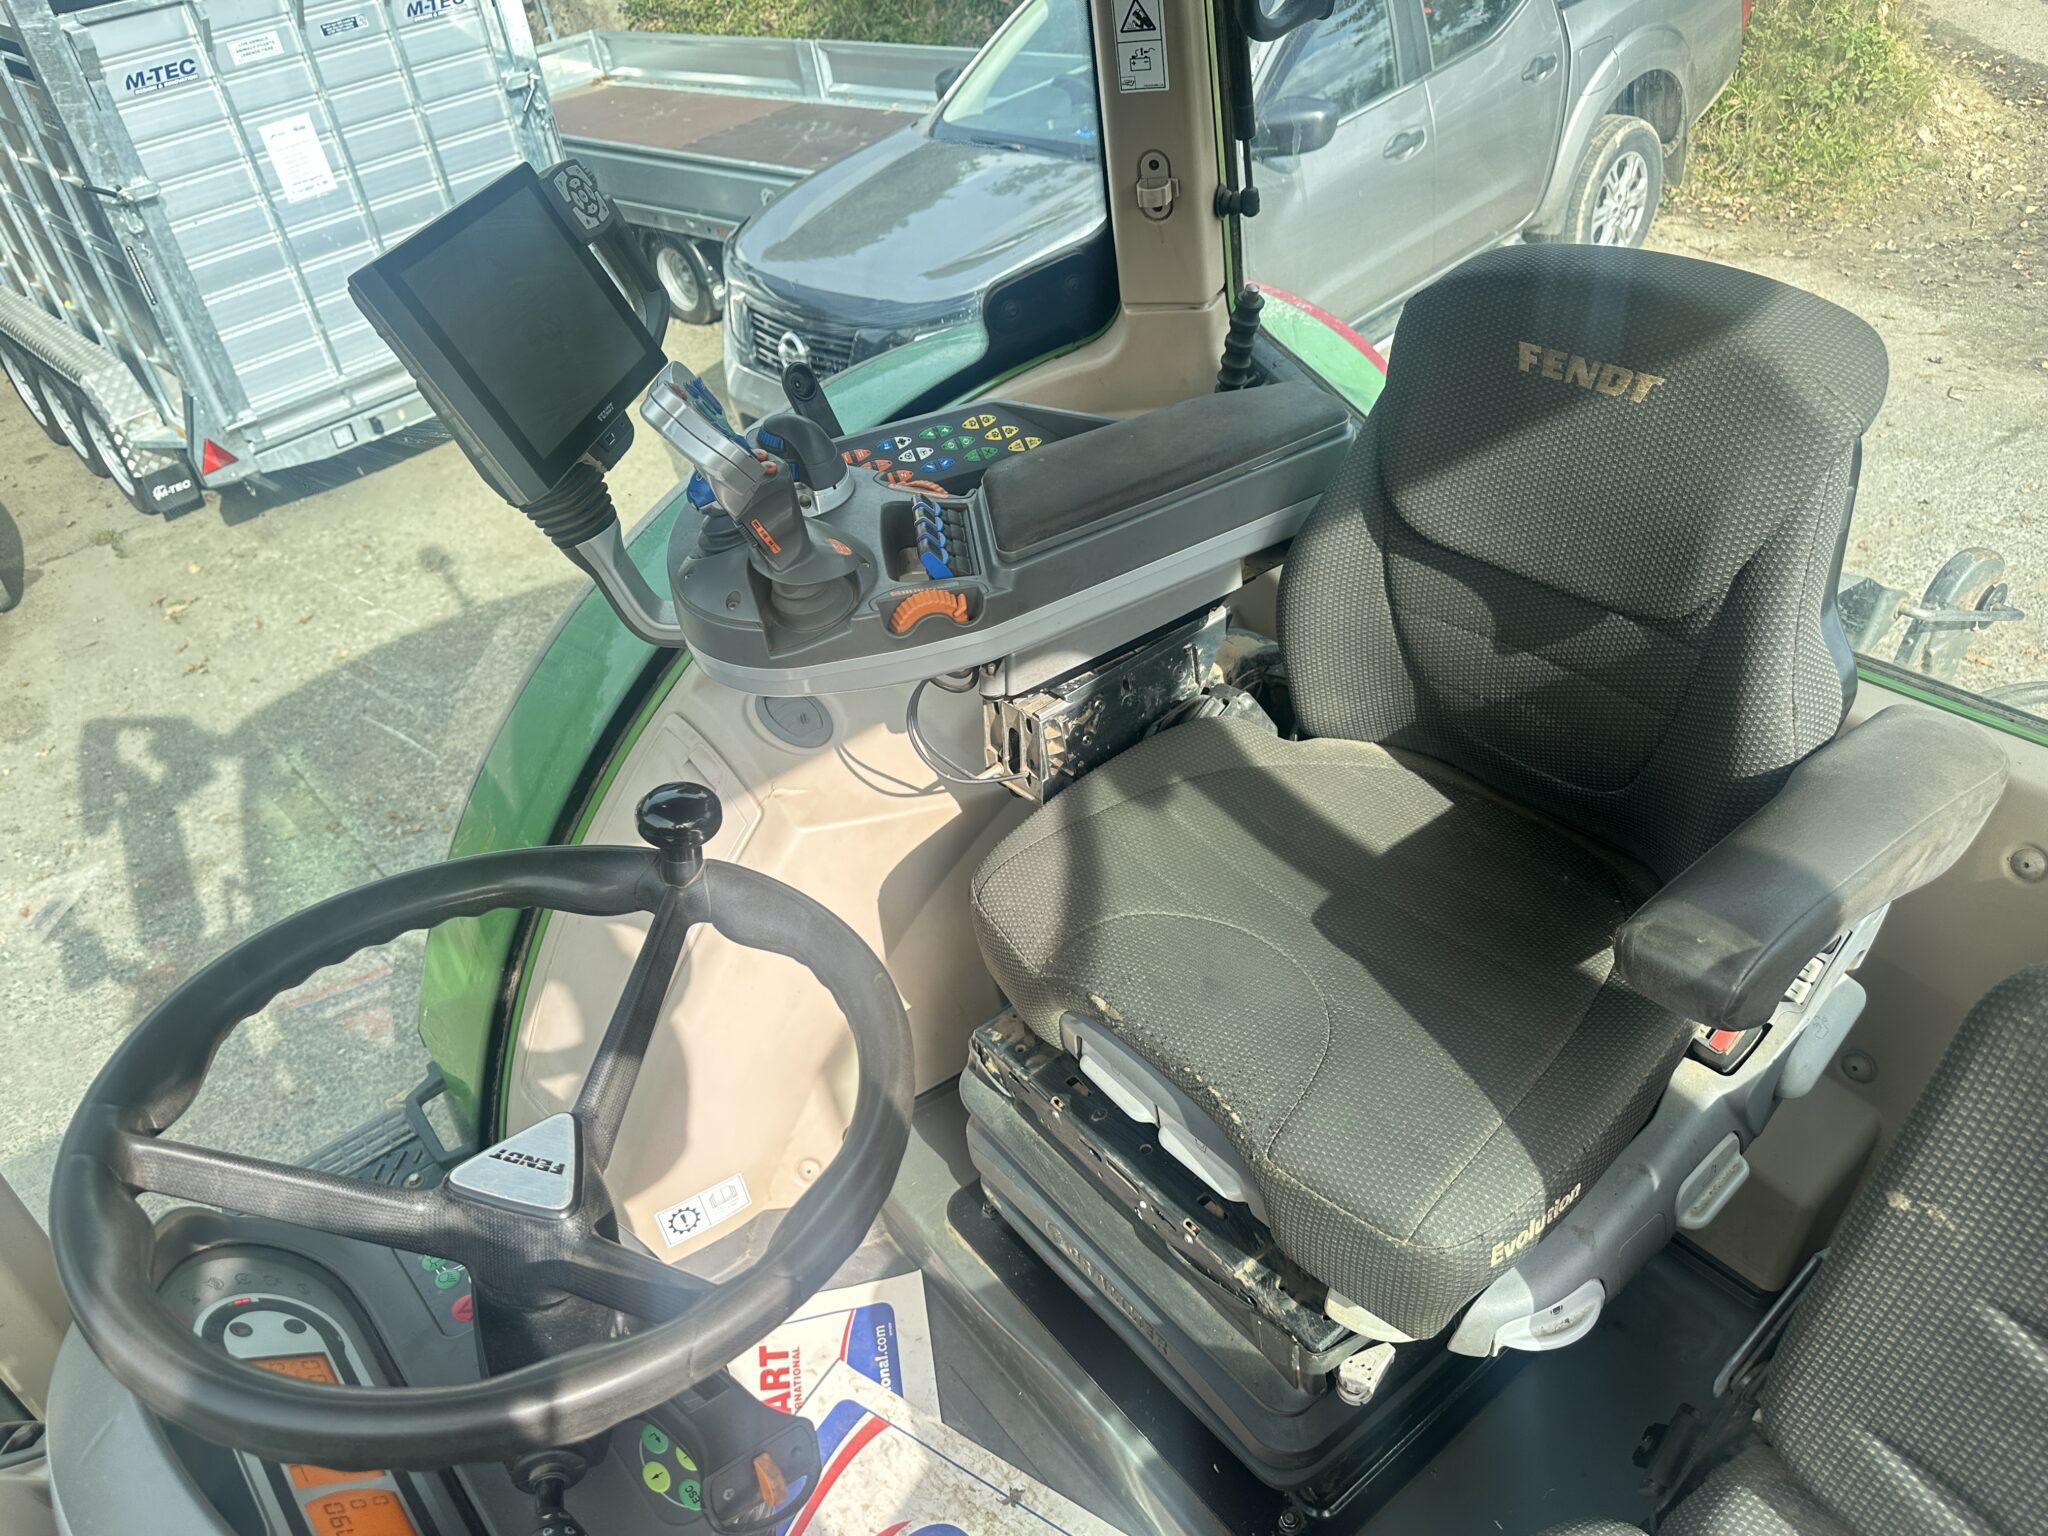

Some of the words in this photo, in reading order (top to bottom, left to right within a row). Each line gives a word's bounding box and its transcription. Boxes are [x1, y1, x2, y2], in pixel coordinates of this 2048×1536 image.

[125, 58, 196, 90] M-TEC
[1518, 340, 1666, 404] FENDT
[488, 1148, 566, 1175] FENDT
[1490, 1182, 1582, 1267] Evolution
[684, 1485, 700, 1504] ESC
